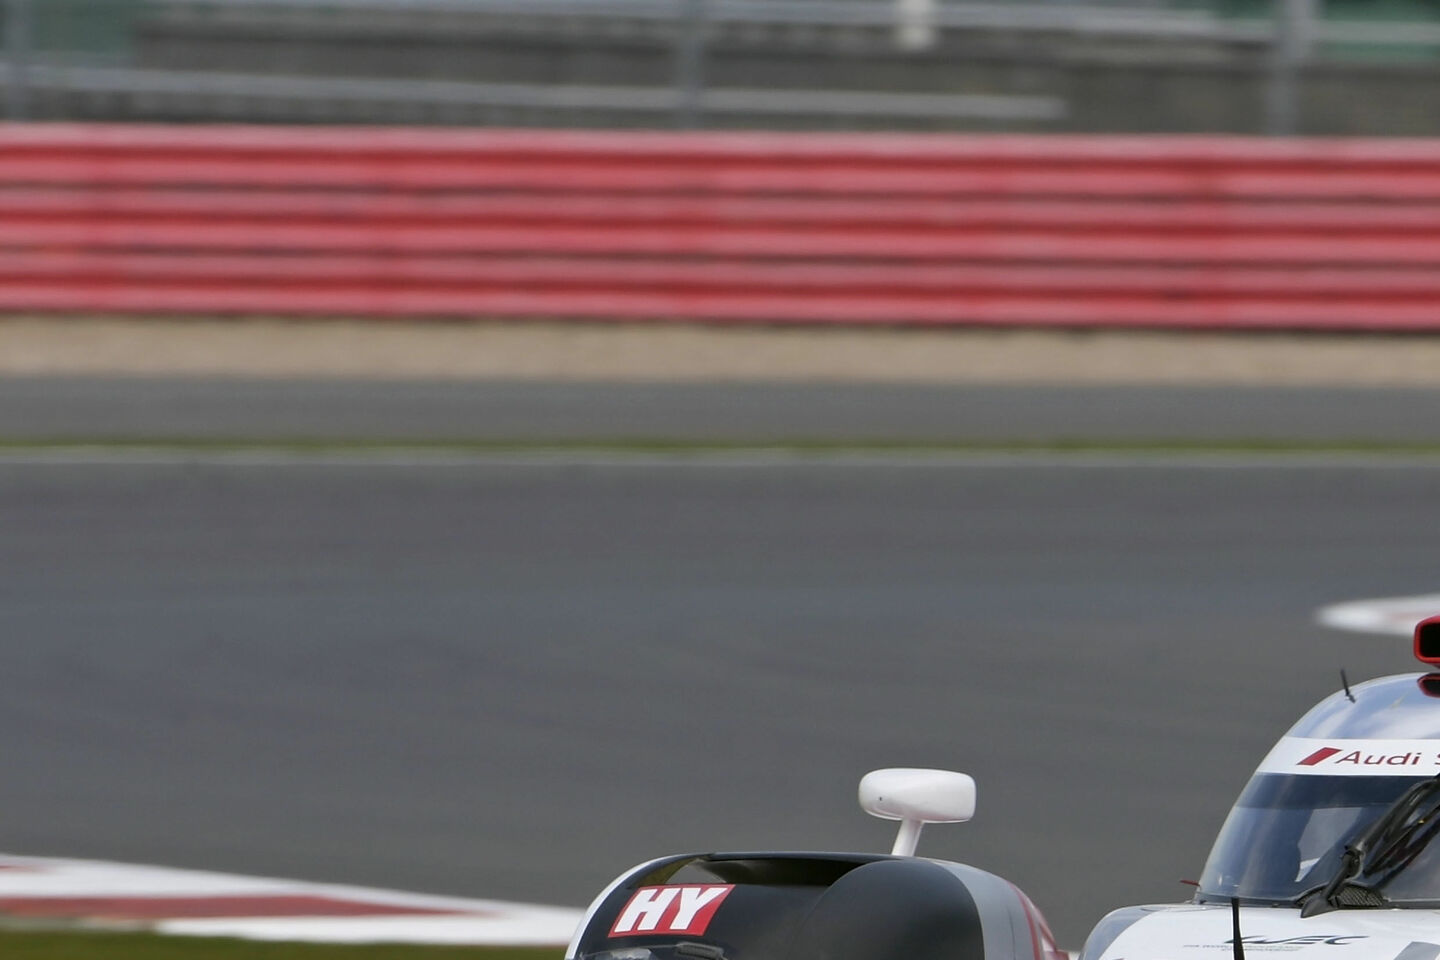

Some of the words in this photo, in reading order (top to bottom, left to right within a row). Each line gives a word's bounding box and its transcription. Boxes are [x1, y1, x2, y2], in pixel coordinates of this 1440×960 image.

[1334, 750, 1423, 766] Audi
[614, 887, 729, 933] HY
[1223, 935, 1371, 946] WEC
